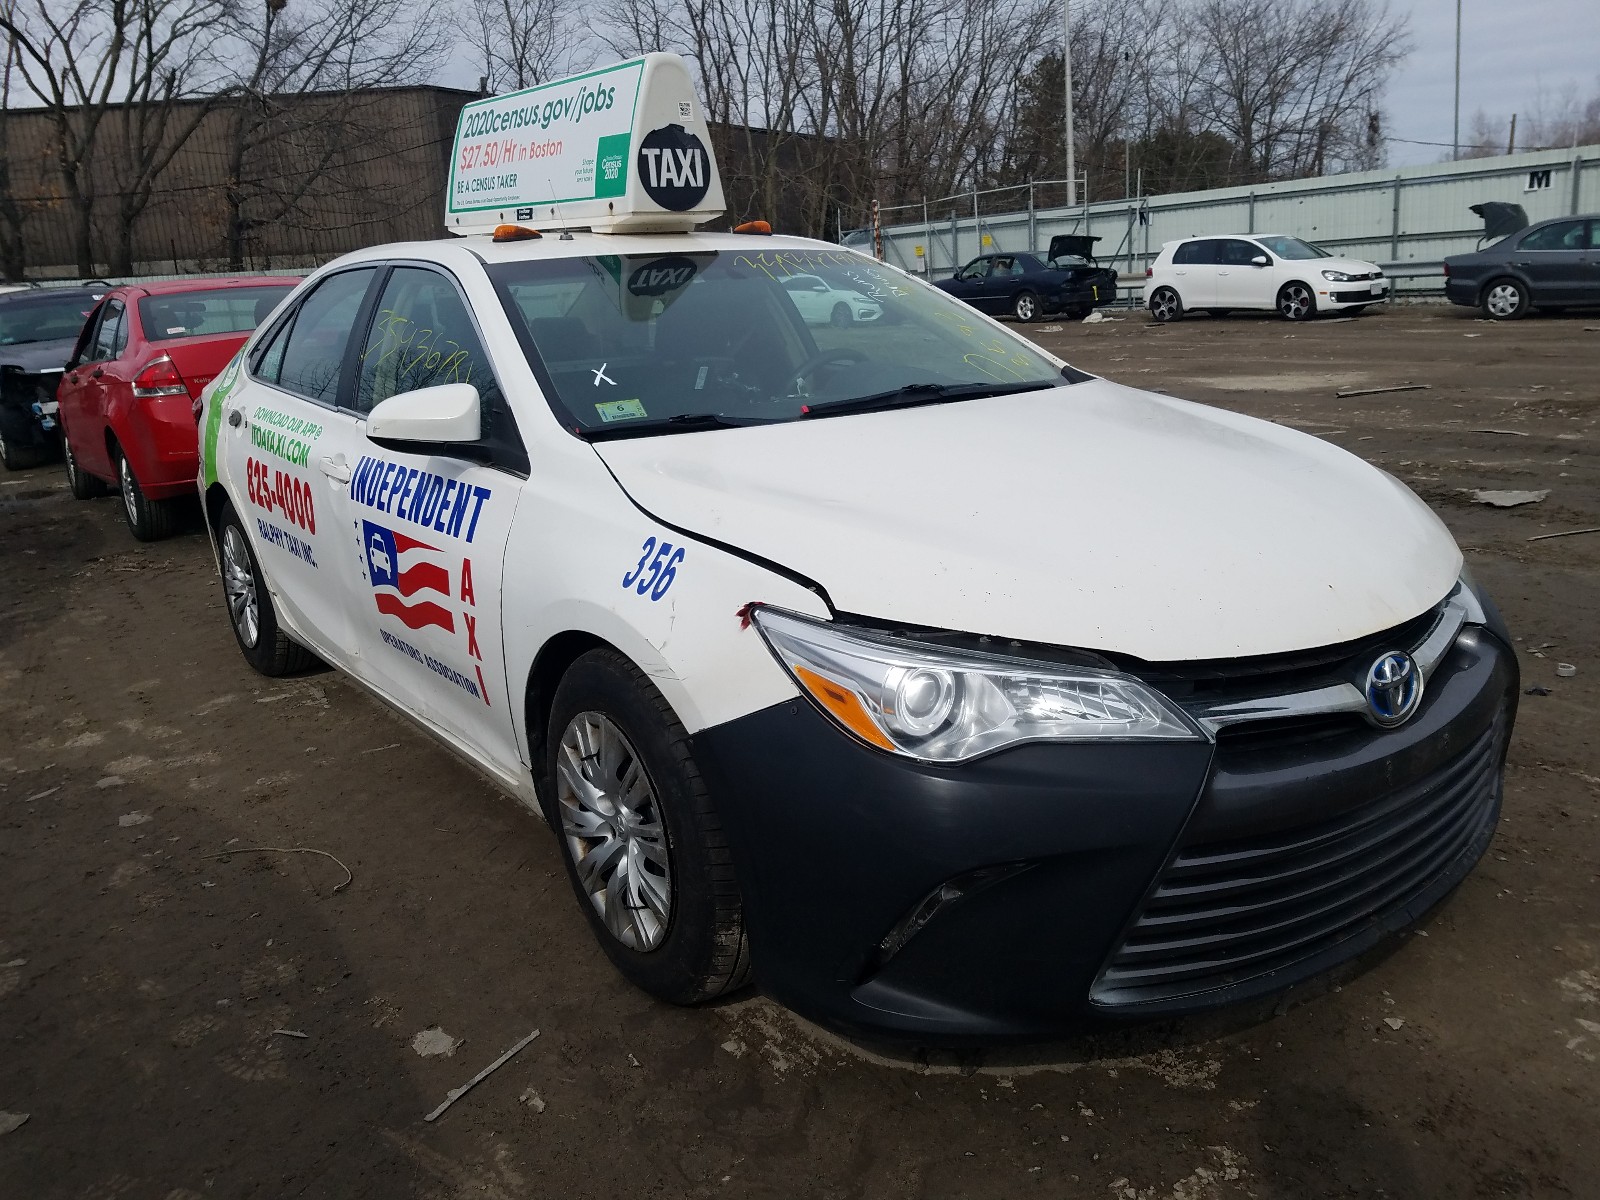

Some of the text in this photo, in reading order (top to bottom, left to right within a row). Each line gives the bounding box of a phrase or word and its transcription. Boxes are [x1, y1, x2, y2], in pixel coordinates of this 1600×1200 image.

[463, 83, 616, 138] 2020census.gov/jobs
[461, 138, 562, 174] $27.50/Hr in Boston
[602, 159, 622, 169] Census
[604, 168, 619, 180] 2020
[641, 148, 704, 188] TAXI
[457, 174, 518, 194] BE A CENSUS TAKER
[1528, 170, 1551, 188] M
[253, 406, 290, 428] DOWNLOAD
[286, 417, 304, 434] OUR
[251, 423, 312, 469] ITOATAXI.COM
[246, 456, 316, 536] 825-4000
[350, 455, 492, 544] INDEPENDENT
[256, 517, 318, 569] RALPHY TAXI INC.
[622, 536, 686, 602] 356
[379, 628, 481, 700] OPERATORS ASSOCIATION
